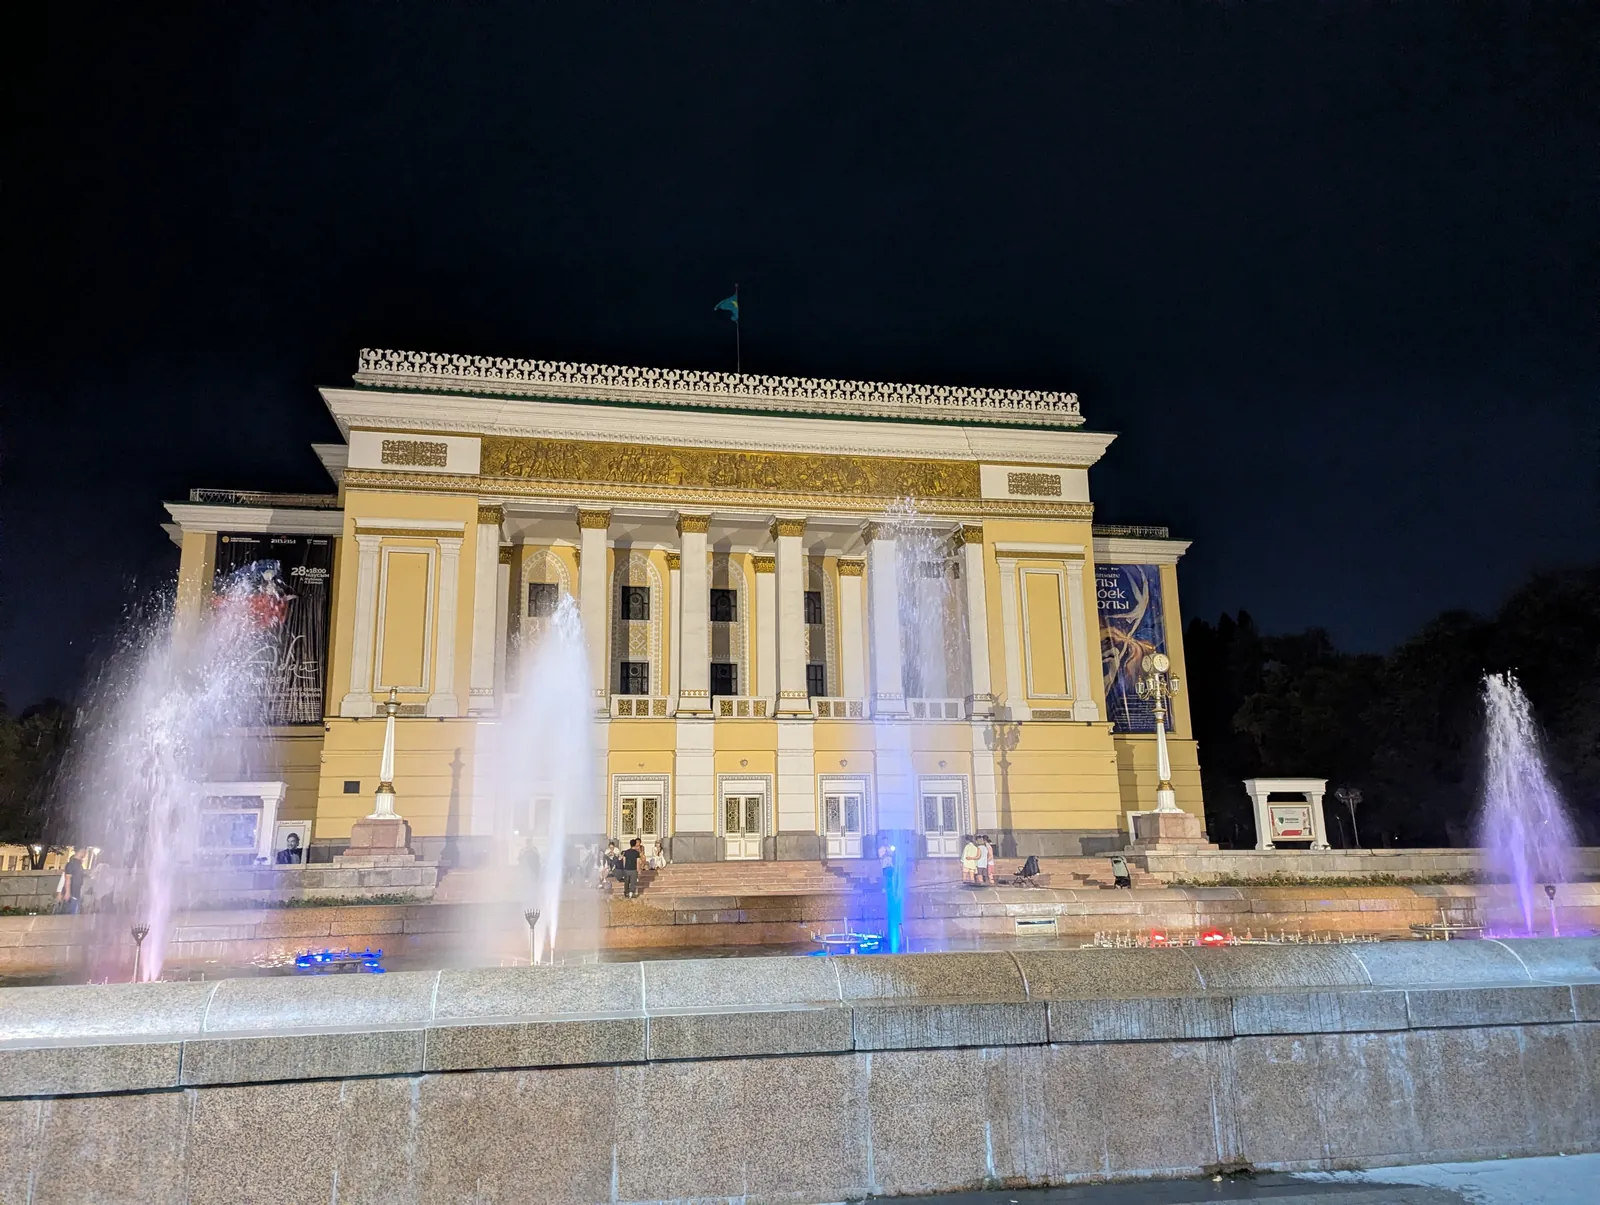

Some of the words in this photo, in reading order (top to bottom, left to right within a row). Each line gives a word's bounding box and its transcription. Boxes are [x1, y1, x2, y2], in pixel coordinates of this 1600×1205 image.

[291, 566, 306, 576] 28
[1096, 579, 1118, 588] лы
[1097, 588, 1126, 599] бек
[1097, 600, 1130, 610] олы
